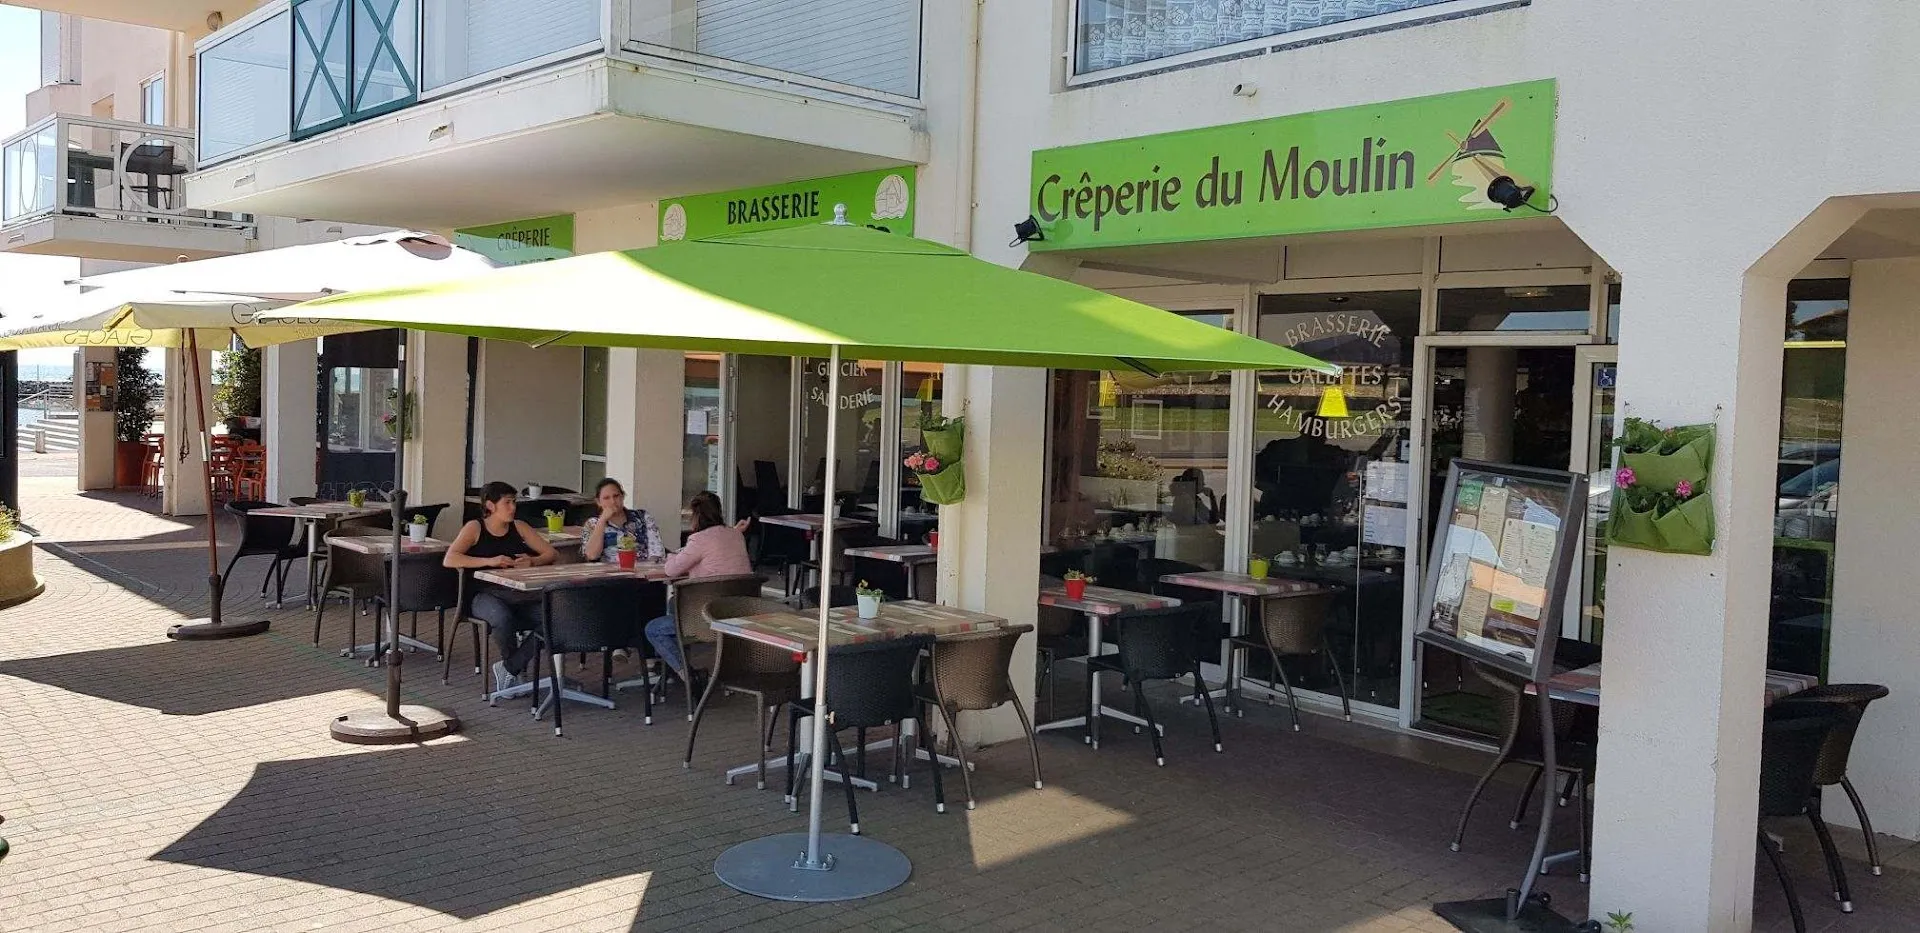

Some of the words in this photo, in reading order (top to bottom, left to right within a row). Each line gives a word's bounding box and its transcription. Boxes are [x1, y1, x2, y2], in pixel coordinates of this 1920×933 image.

[1037, 165, 1181, 232] Crêperie
[1195, 155, 1244, 208] du
[1258, 137, 1415, 203] Moulin
[727, 190, 820, 225] BRASSERIE
[497, 227, 551, 252] CRÊPERIE
[1285, 313, 1390, 349] BRASSERIE
[817, 361, 868, 377] GLCIER
[811, 386, 875, 411] SALDERIE
[1267, 394, 1402, 440] HAMBURGERS
